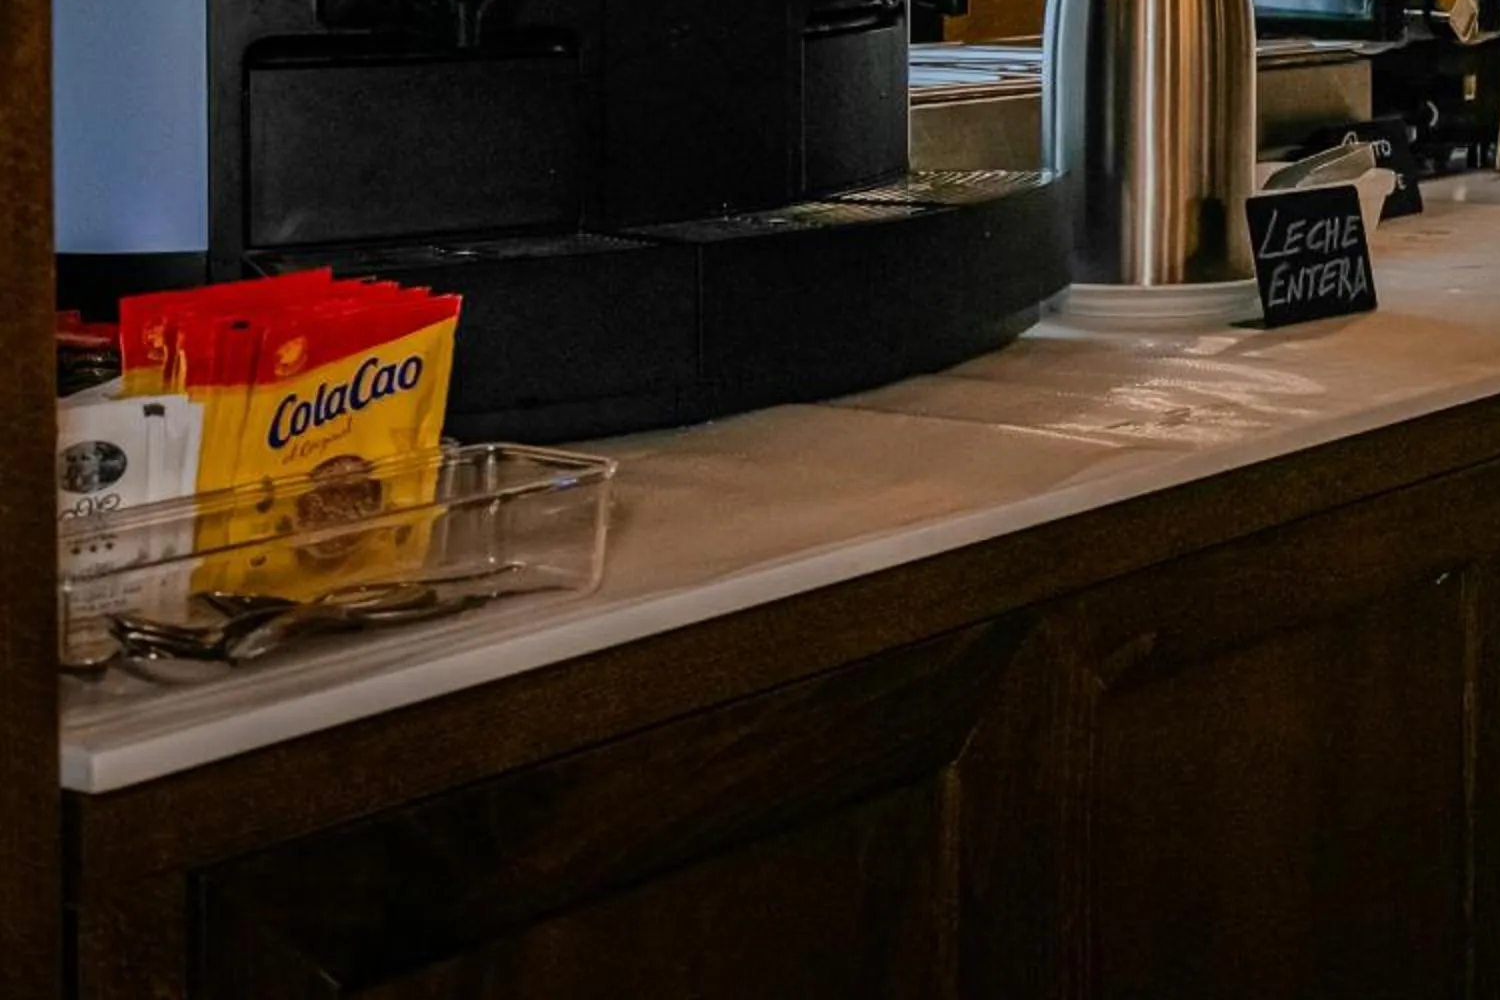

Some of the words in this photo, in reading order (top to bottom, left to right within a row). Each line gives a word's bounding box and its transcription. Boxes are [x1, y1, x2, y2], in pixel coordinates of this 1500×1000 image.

[1260, 208, 1361, 259] LECHE
[1268, 255, 1368, 307] ENTERA
[268, 355, 423, 449] ColaCao
